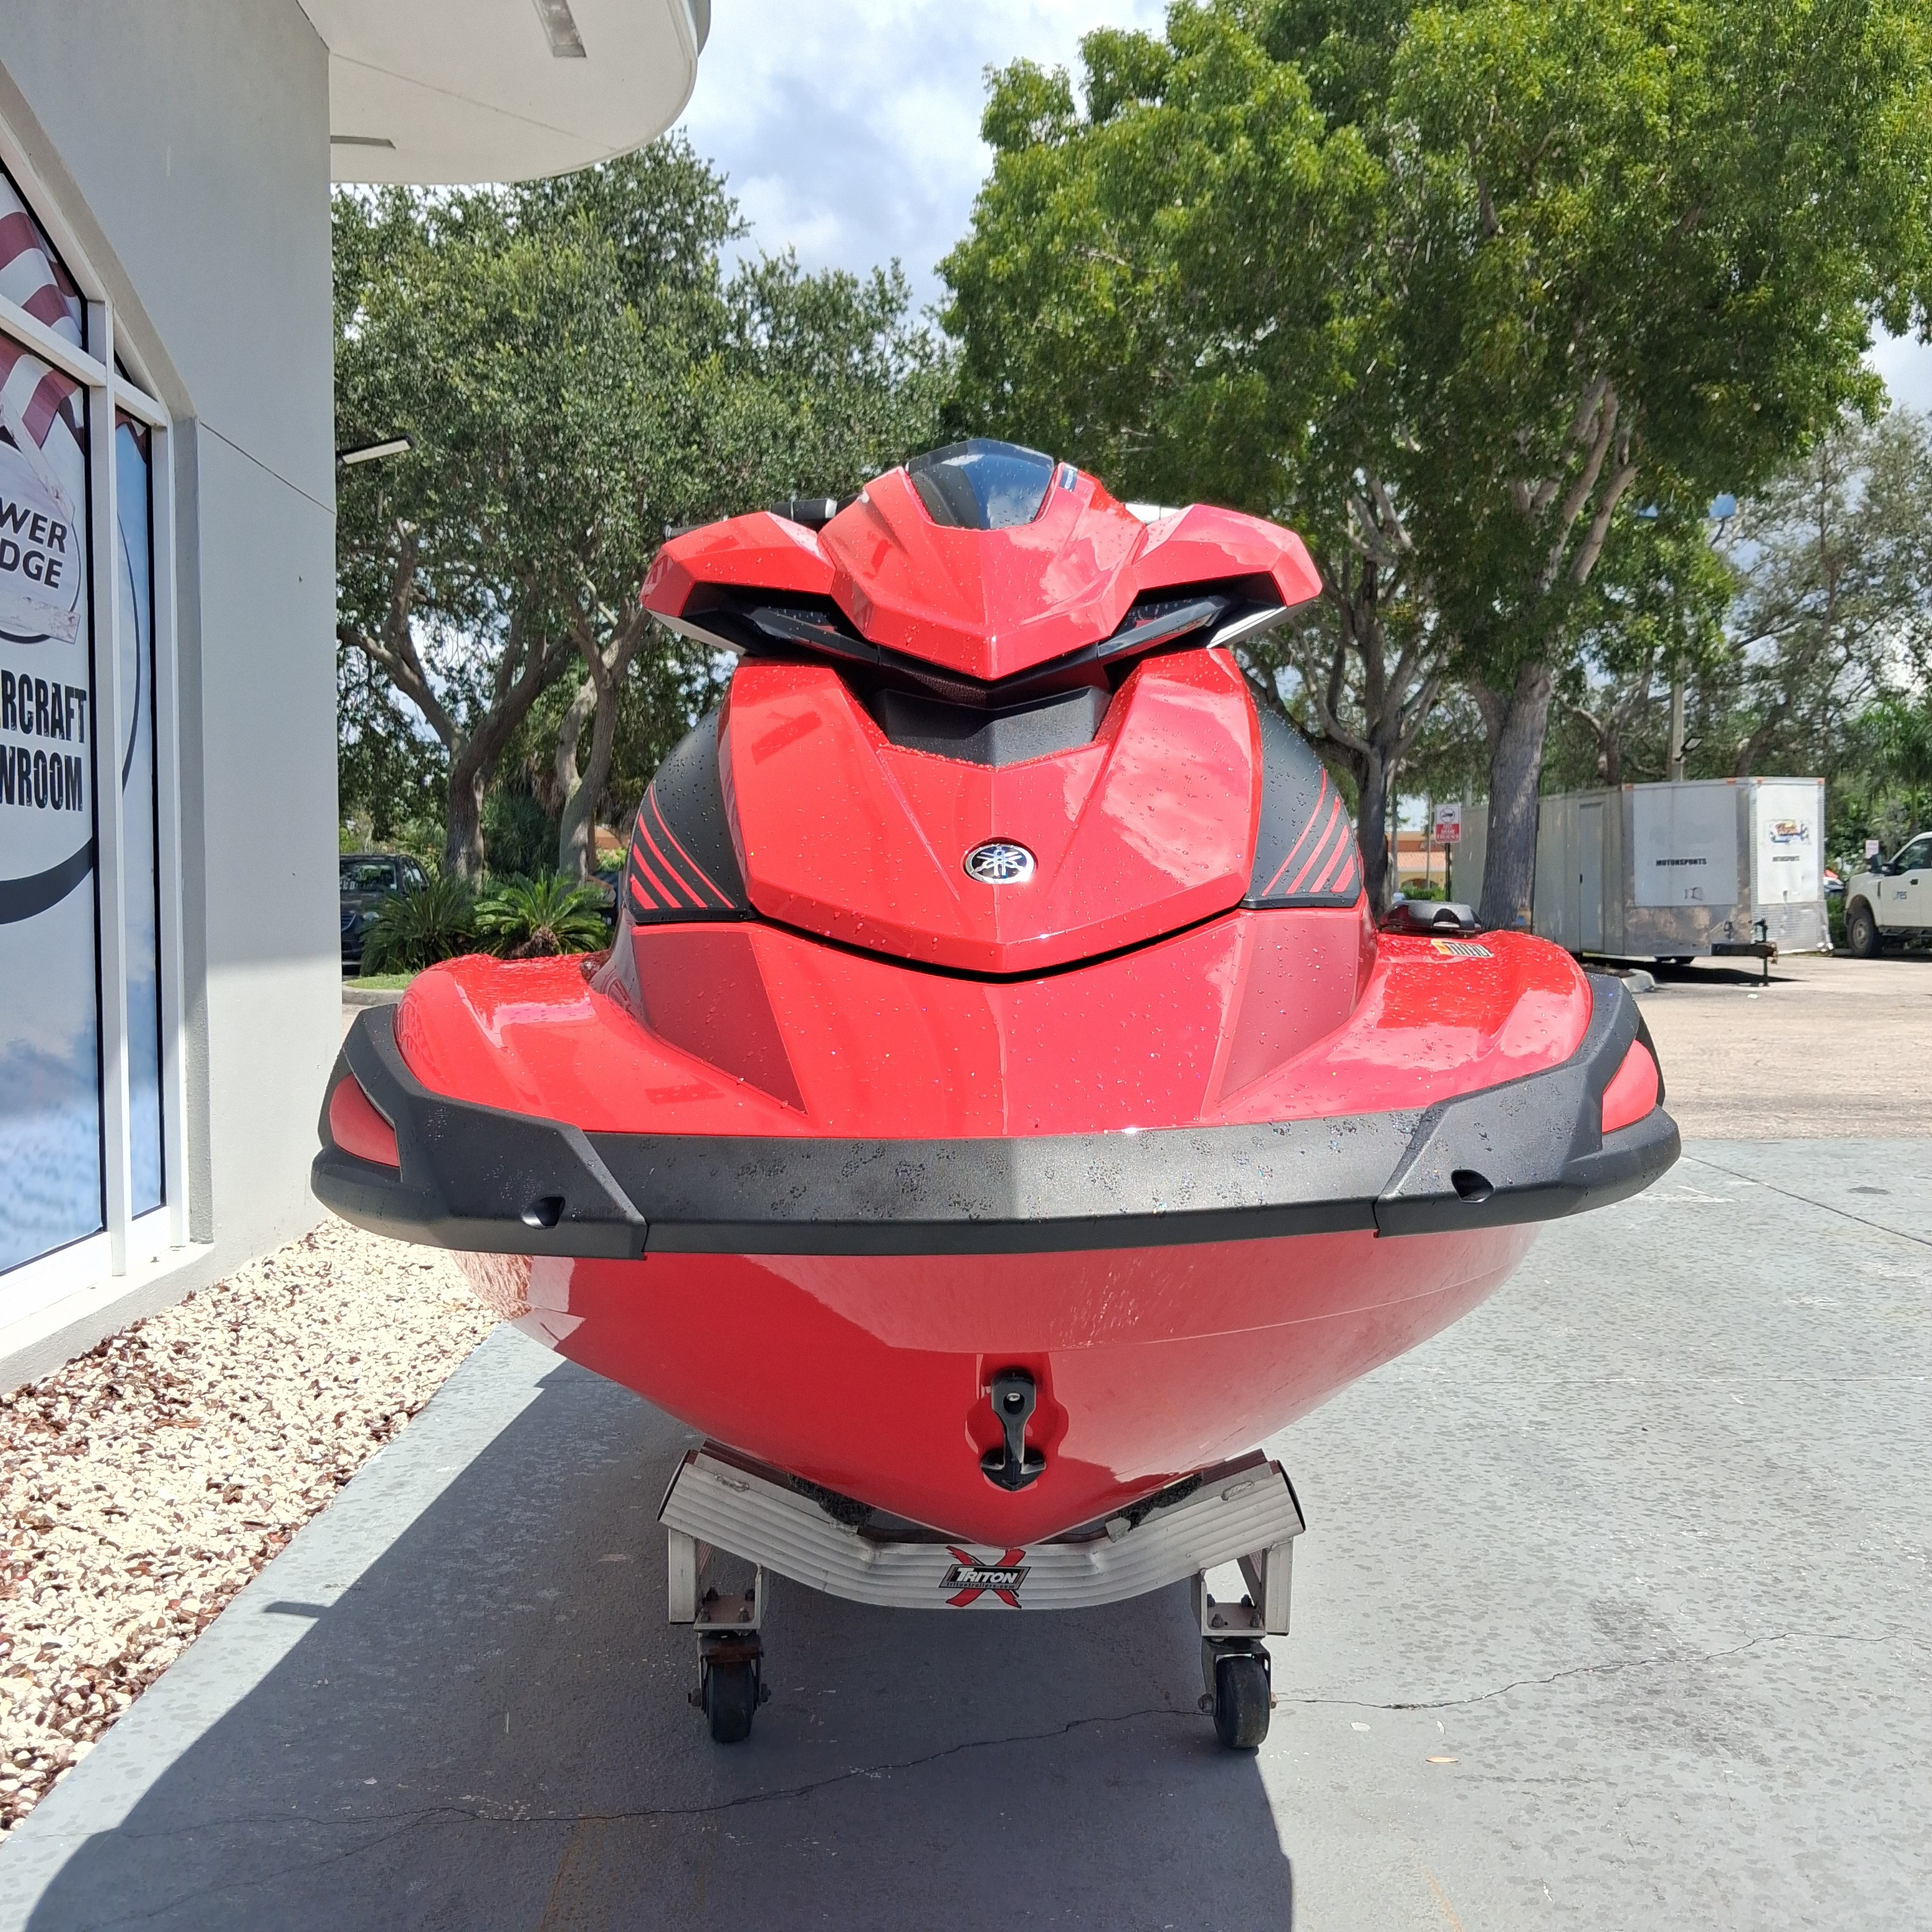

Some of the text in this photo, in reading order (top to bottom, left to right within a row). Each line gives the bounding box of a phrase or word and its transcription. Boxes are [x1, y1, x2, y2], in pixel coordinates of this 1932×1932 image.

[0, 537, 63, 589] DGE
[0, 669, 87, 743] RCRAFT
[1656, 858, 1707, 867] MOTORSPORTS
